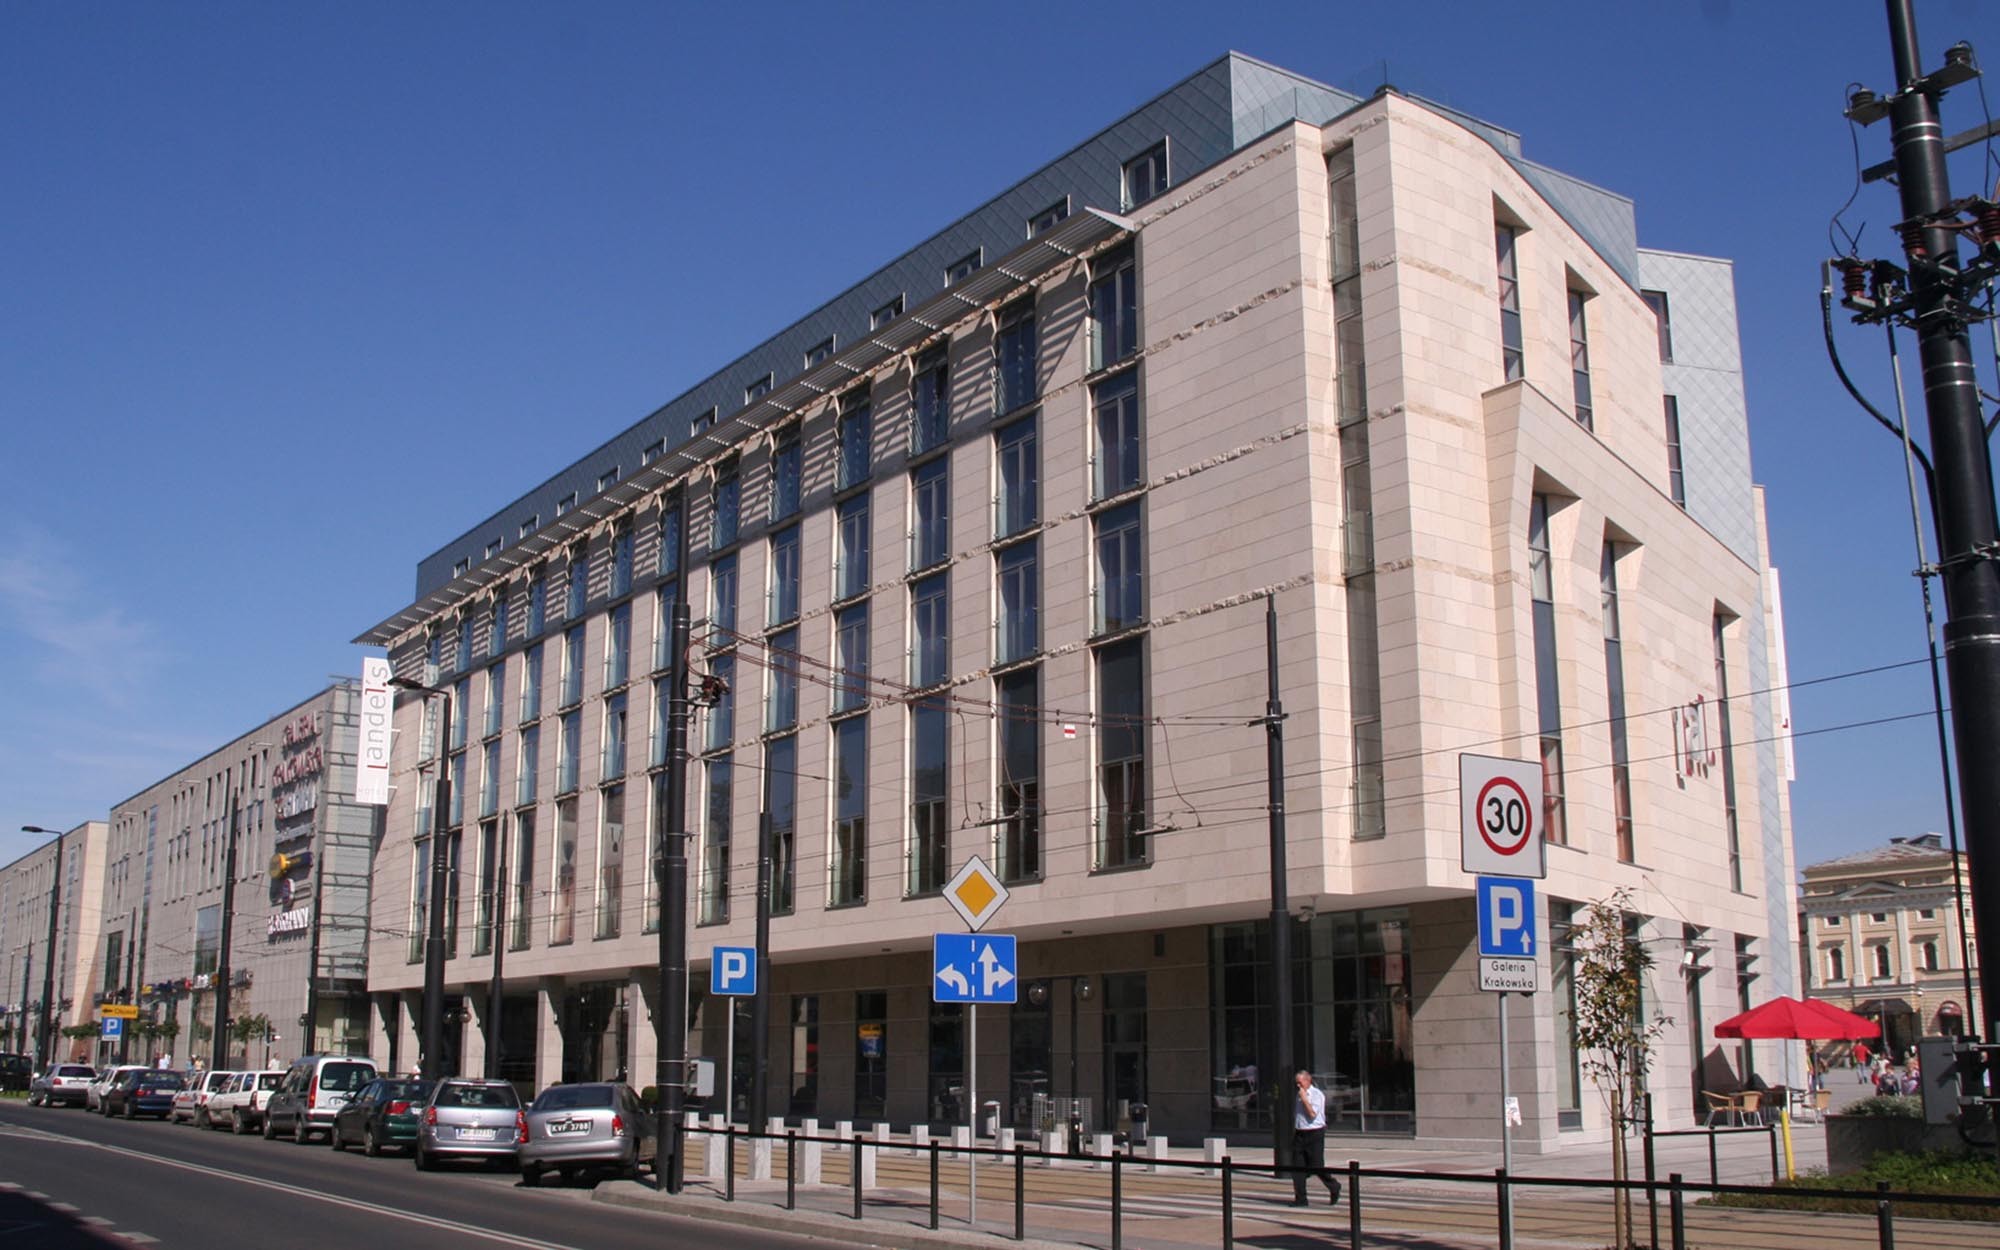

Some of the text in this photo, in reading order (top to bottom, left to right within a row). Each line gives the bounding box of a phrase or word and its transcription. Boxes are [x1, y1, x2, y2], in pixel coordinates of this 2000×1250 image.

[1486, 797, 1524, 836] 30
[1489, 885, 1523, 947] P
[721, 951, 746, 989] P
[1491, 960, 1526, 972] Galeria
[1484, 976, 1533, 988] Krakowska
[106, 1018, 118, 1033] P
